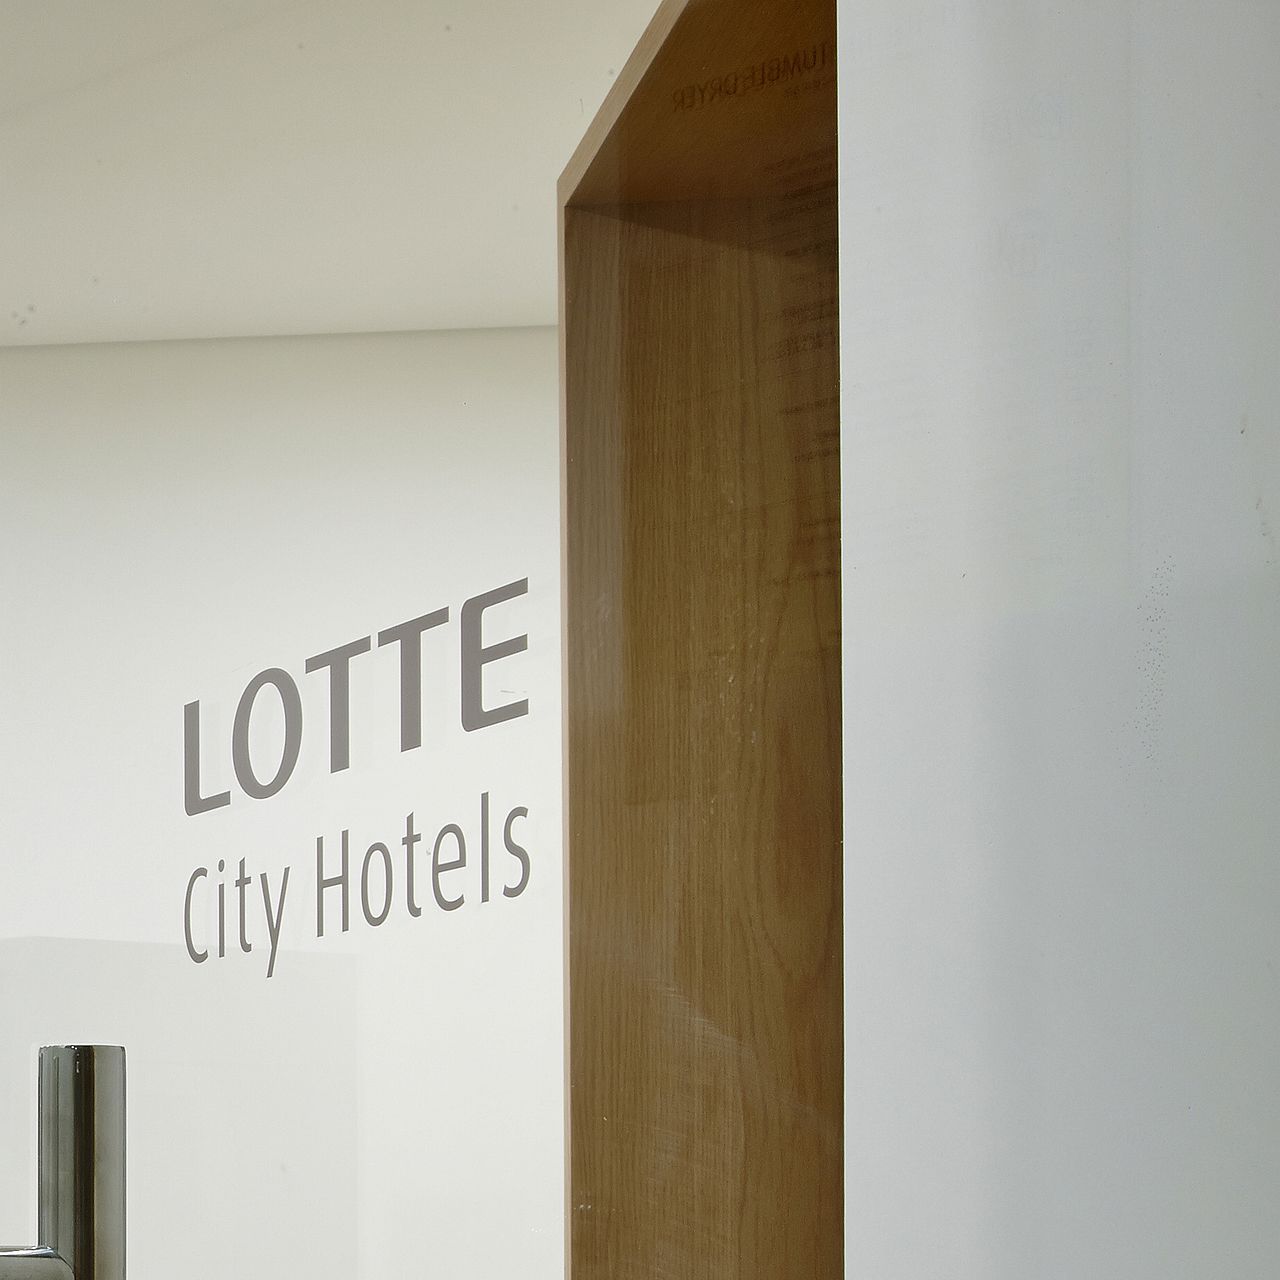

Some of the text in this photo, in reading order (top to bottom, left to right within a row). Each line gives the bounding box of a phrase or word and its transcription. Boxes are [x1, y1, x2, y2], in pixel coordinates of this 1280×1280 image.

[183, 576, 529, 817] LOTTE
[184, 791, 531, 979] City Hotels
